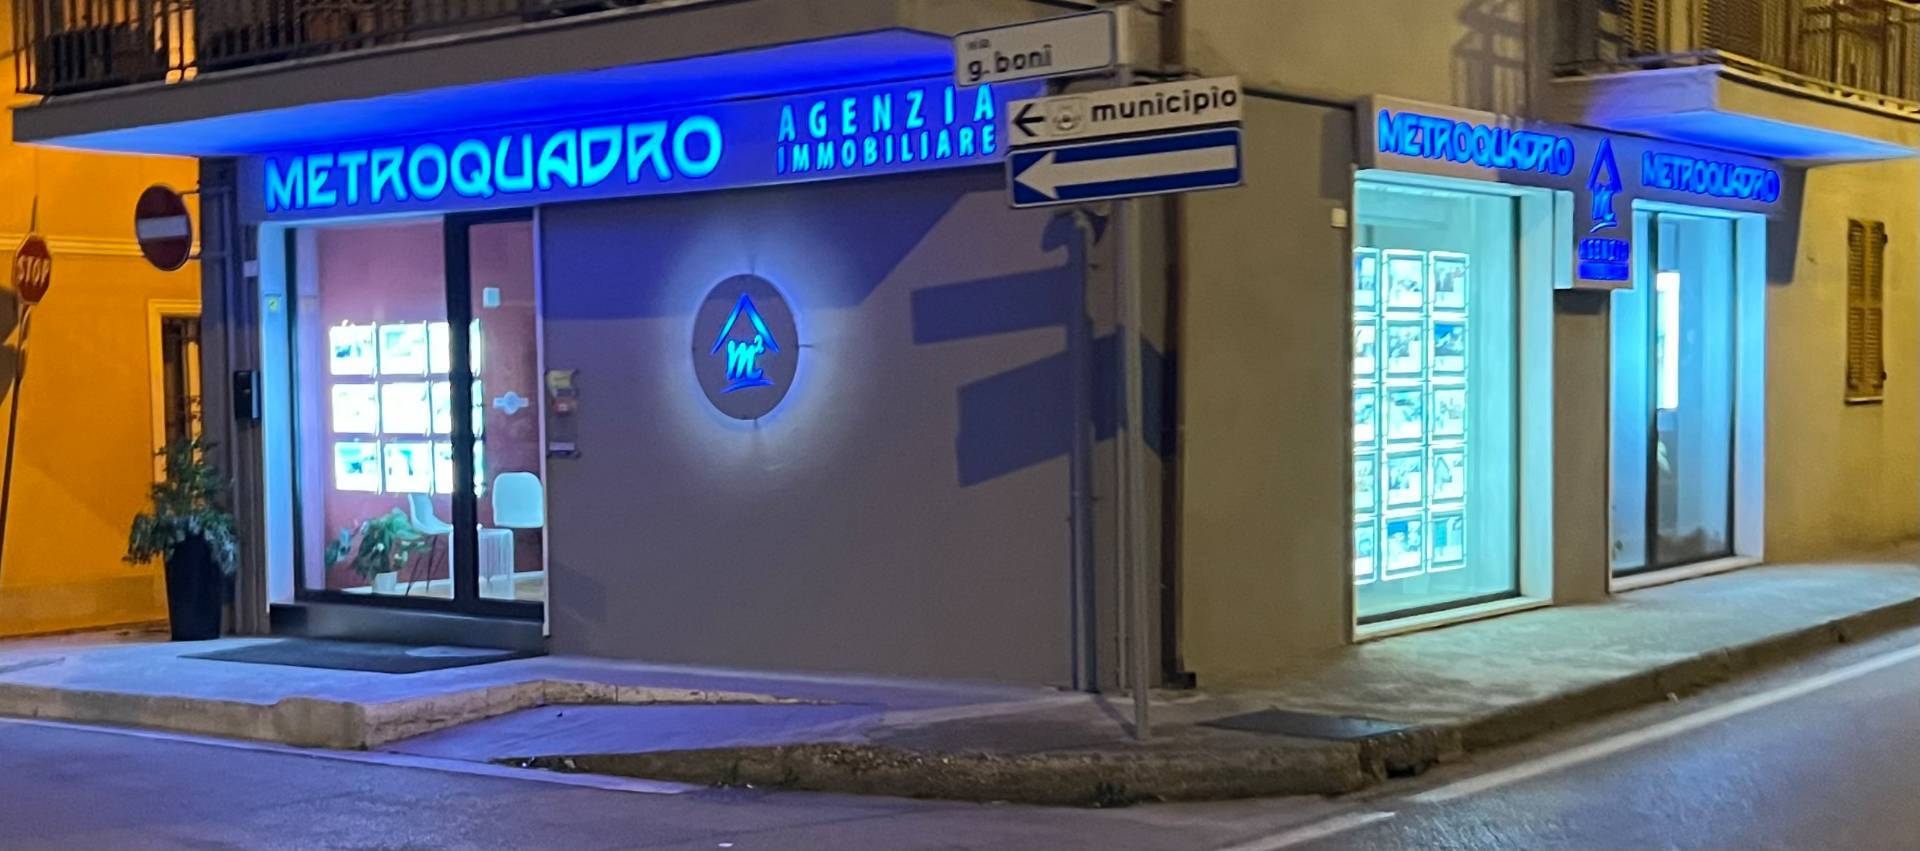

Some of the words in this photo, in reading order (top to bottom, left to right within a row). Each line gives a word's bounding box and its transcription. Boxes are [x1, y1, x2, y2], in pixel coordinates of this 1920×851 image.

[968, 60, 991, 82] g.
[995, 44, 1052, 73] boni
[778, 84, 995, 143] AGENZIA
[1091, 86, 1238, 122] municipio
[265, 115, 722, 212] METROQUADRO
[777, 123, 995, 174] IMMOBILIARE
[1378, 109, 1575, 175] METROQUADRO
[1642, 151, 1780, 202] METROQUADRO
[16, 255, 50, 286] STOP
